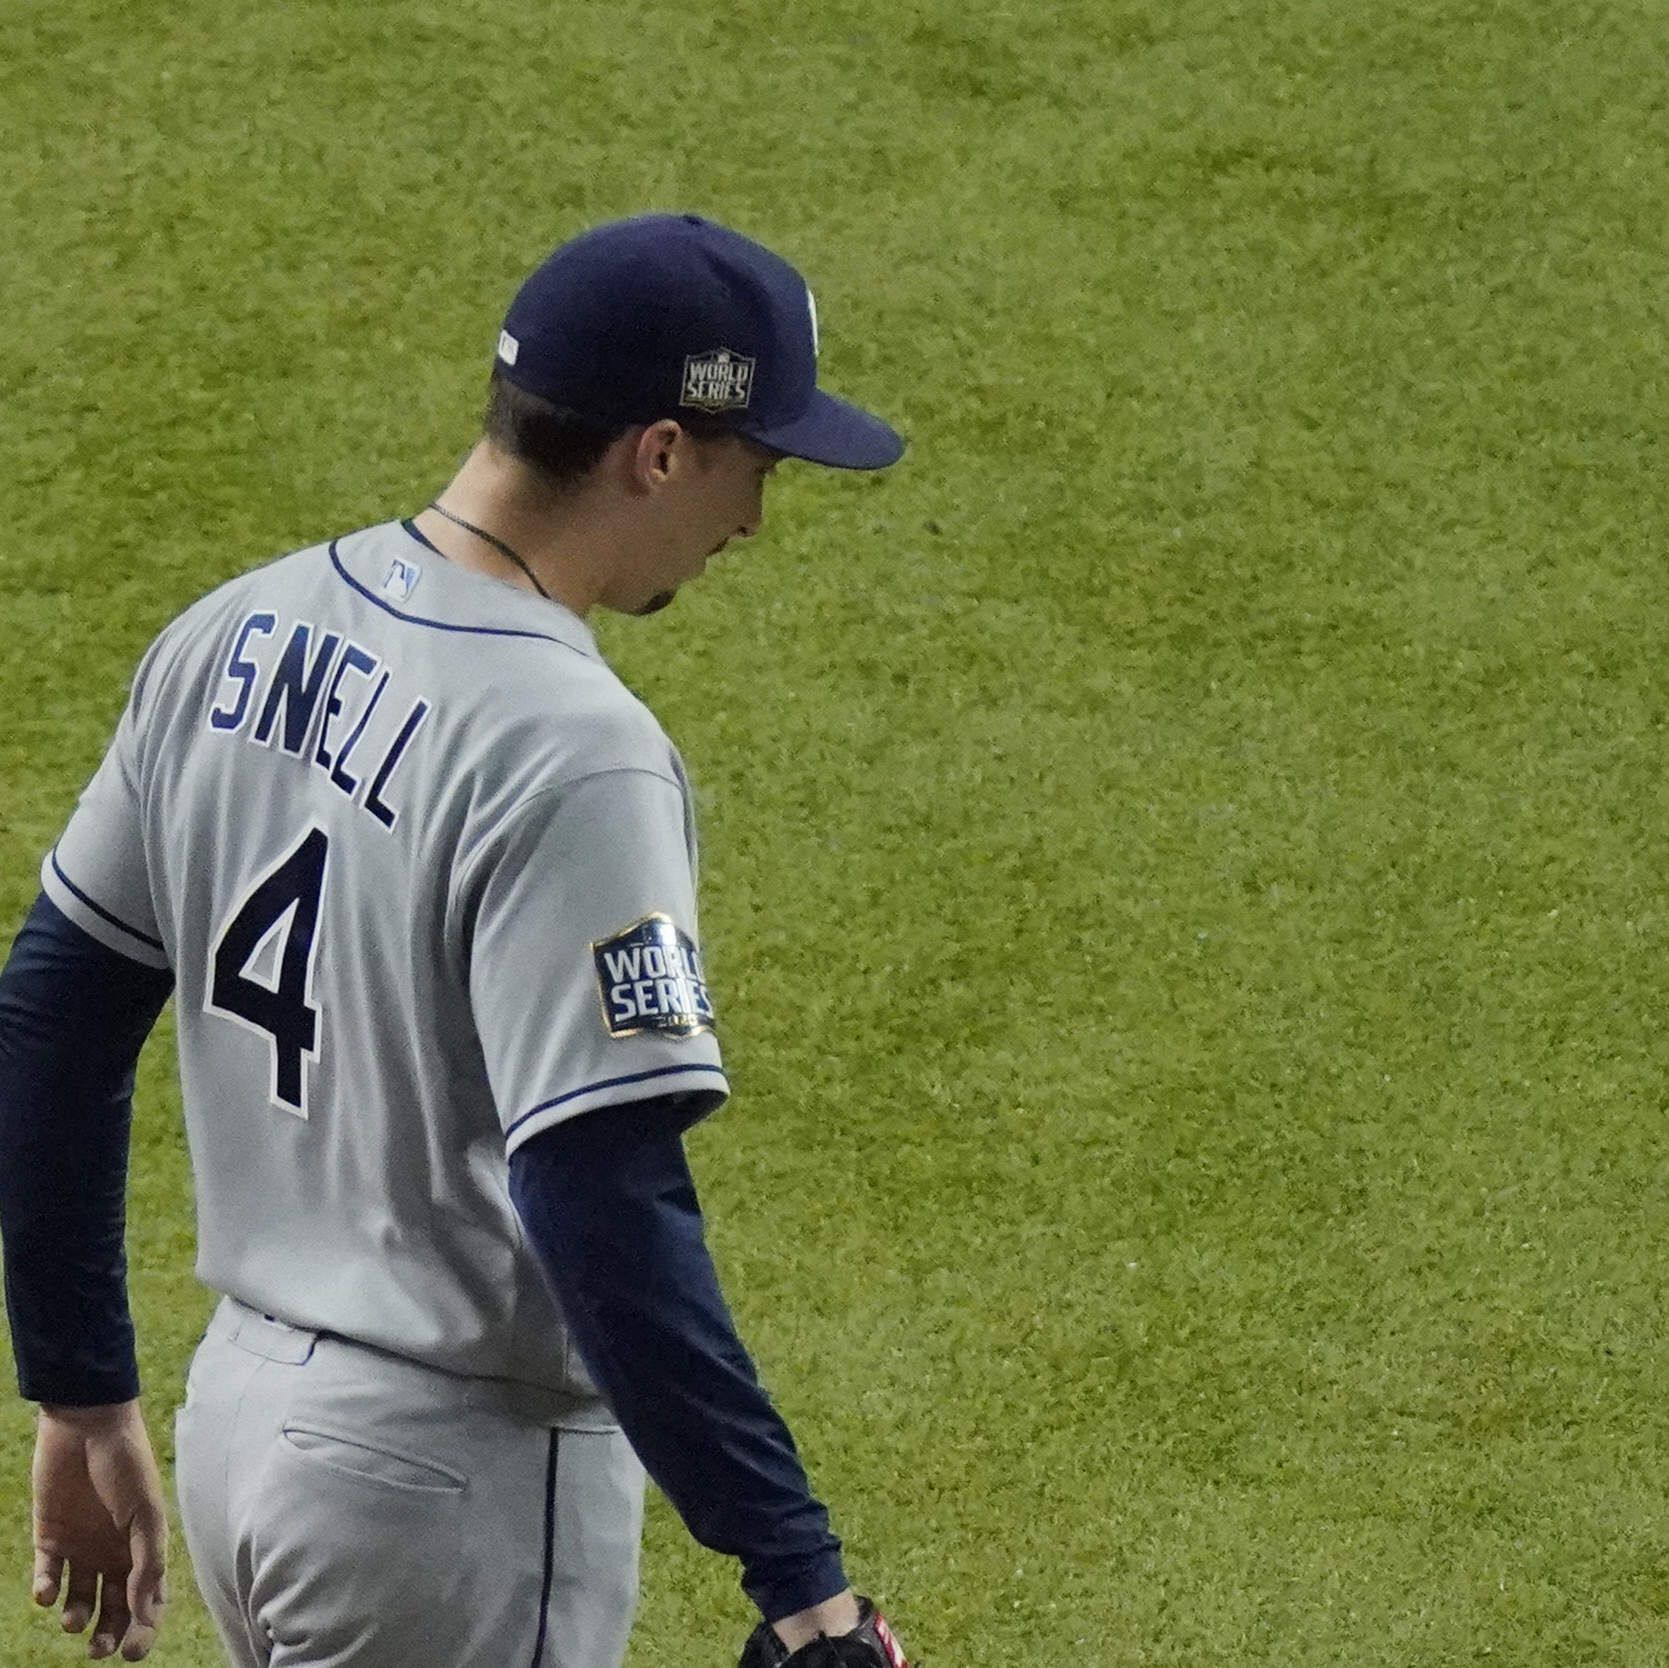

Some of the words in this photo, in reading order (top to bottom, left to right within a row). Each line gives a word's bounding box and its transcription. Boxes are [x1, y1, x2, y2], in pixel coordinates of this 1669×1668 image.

[687, 380, 746, 400] SERIES
[689, 362, 749, 382] WORLD
[208, 608, 432, 835] SNELL
[204, 823, 330, 1120] 4
